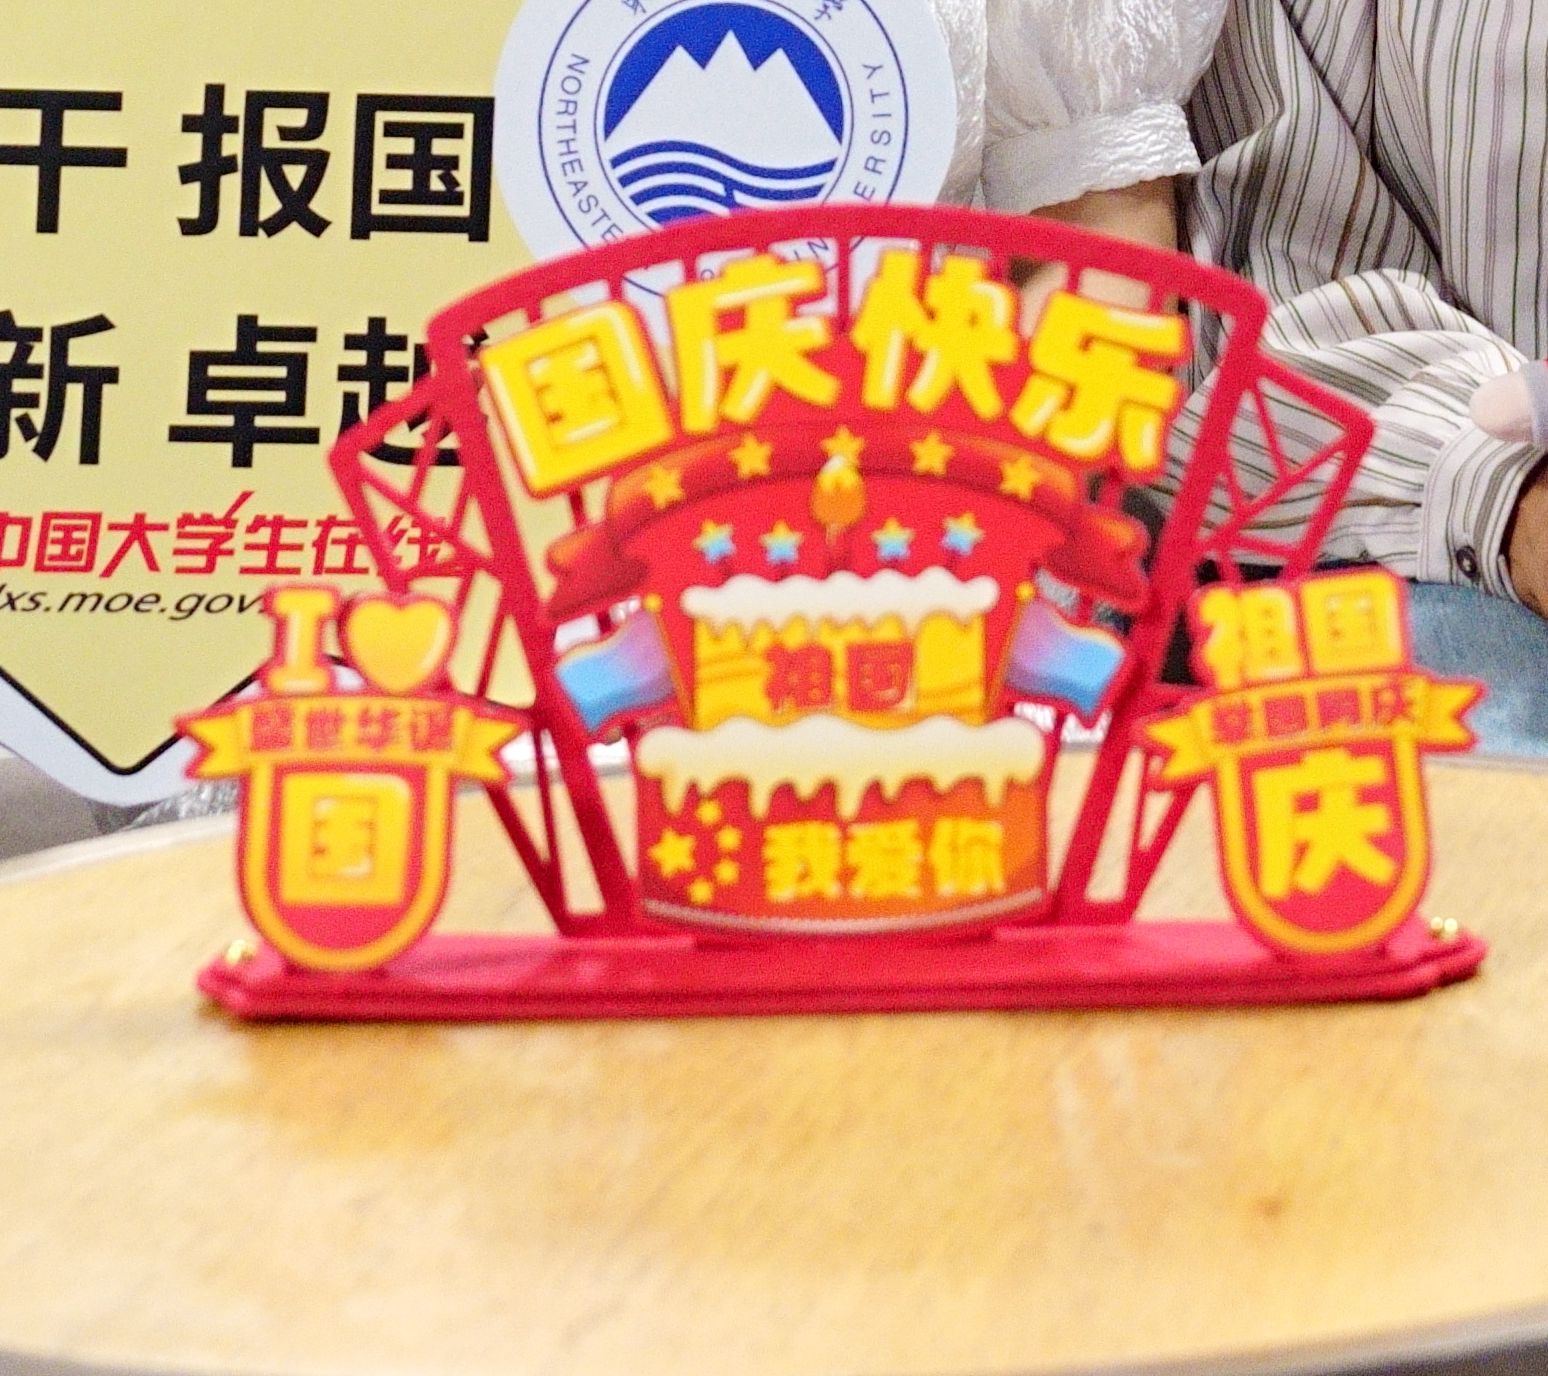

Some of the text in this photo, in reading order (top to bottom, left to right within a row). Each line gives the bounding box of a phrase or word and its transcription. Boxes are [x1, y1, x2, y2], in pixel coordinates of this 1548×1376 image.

[176, 83, 495, 243] 报国
[480, 250, 1188, 494] 国庆快乐
[764, 640, 915, 715] 祖国
[1198, 571, 1405, 689] 祖国
[282, 770, 412, 906] 国
[761, 816, 1007, 903] 我爱你
[1253, 748, 1397, 899] 庆
